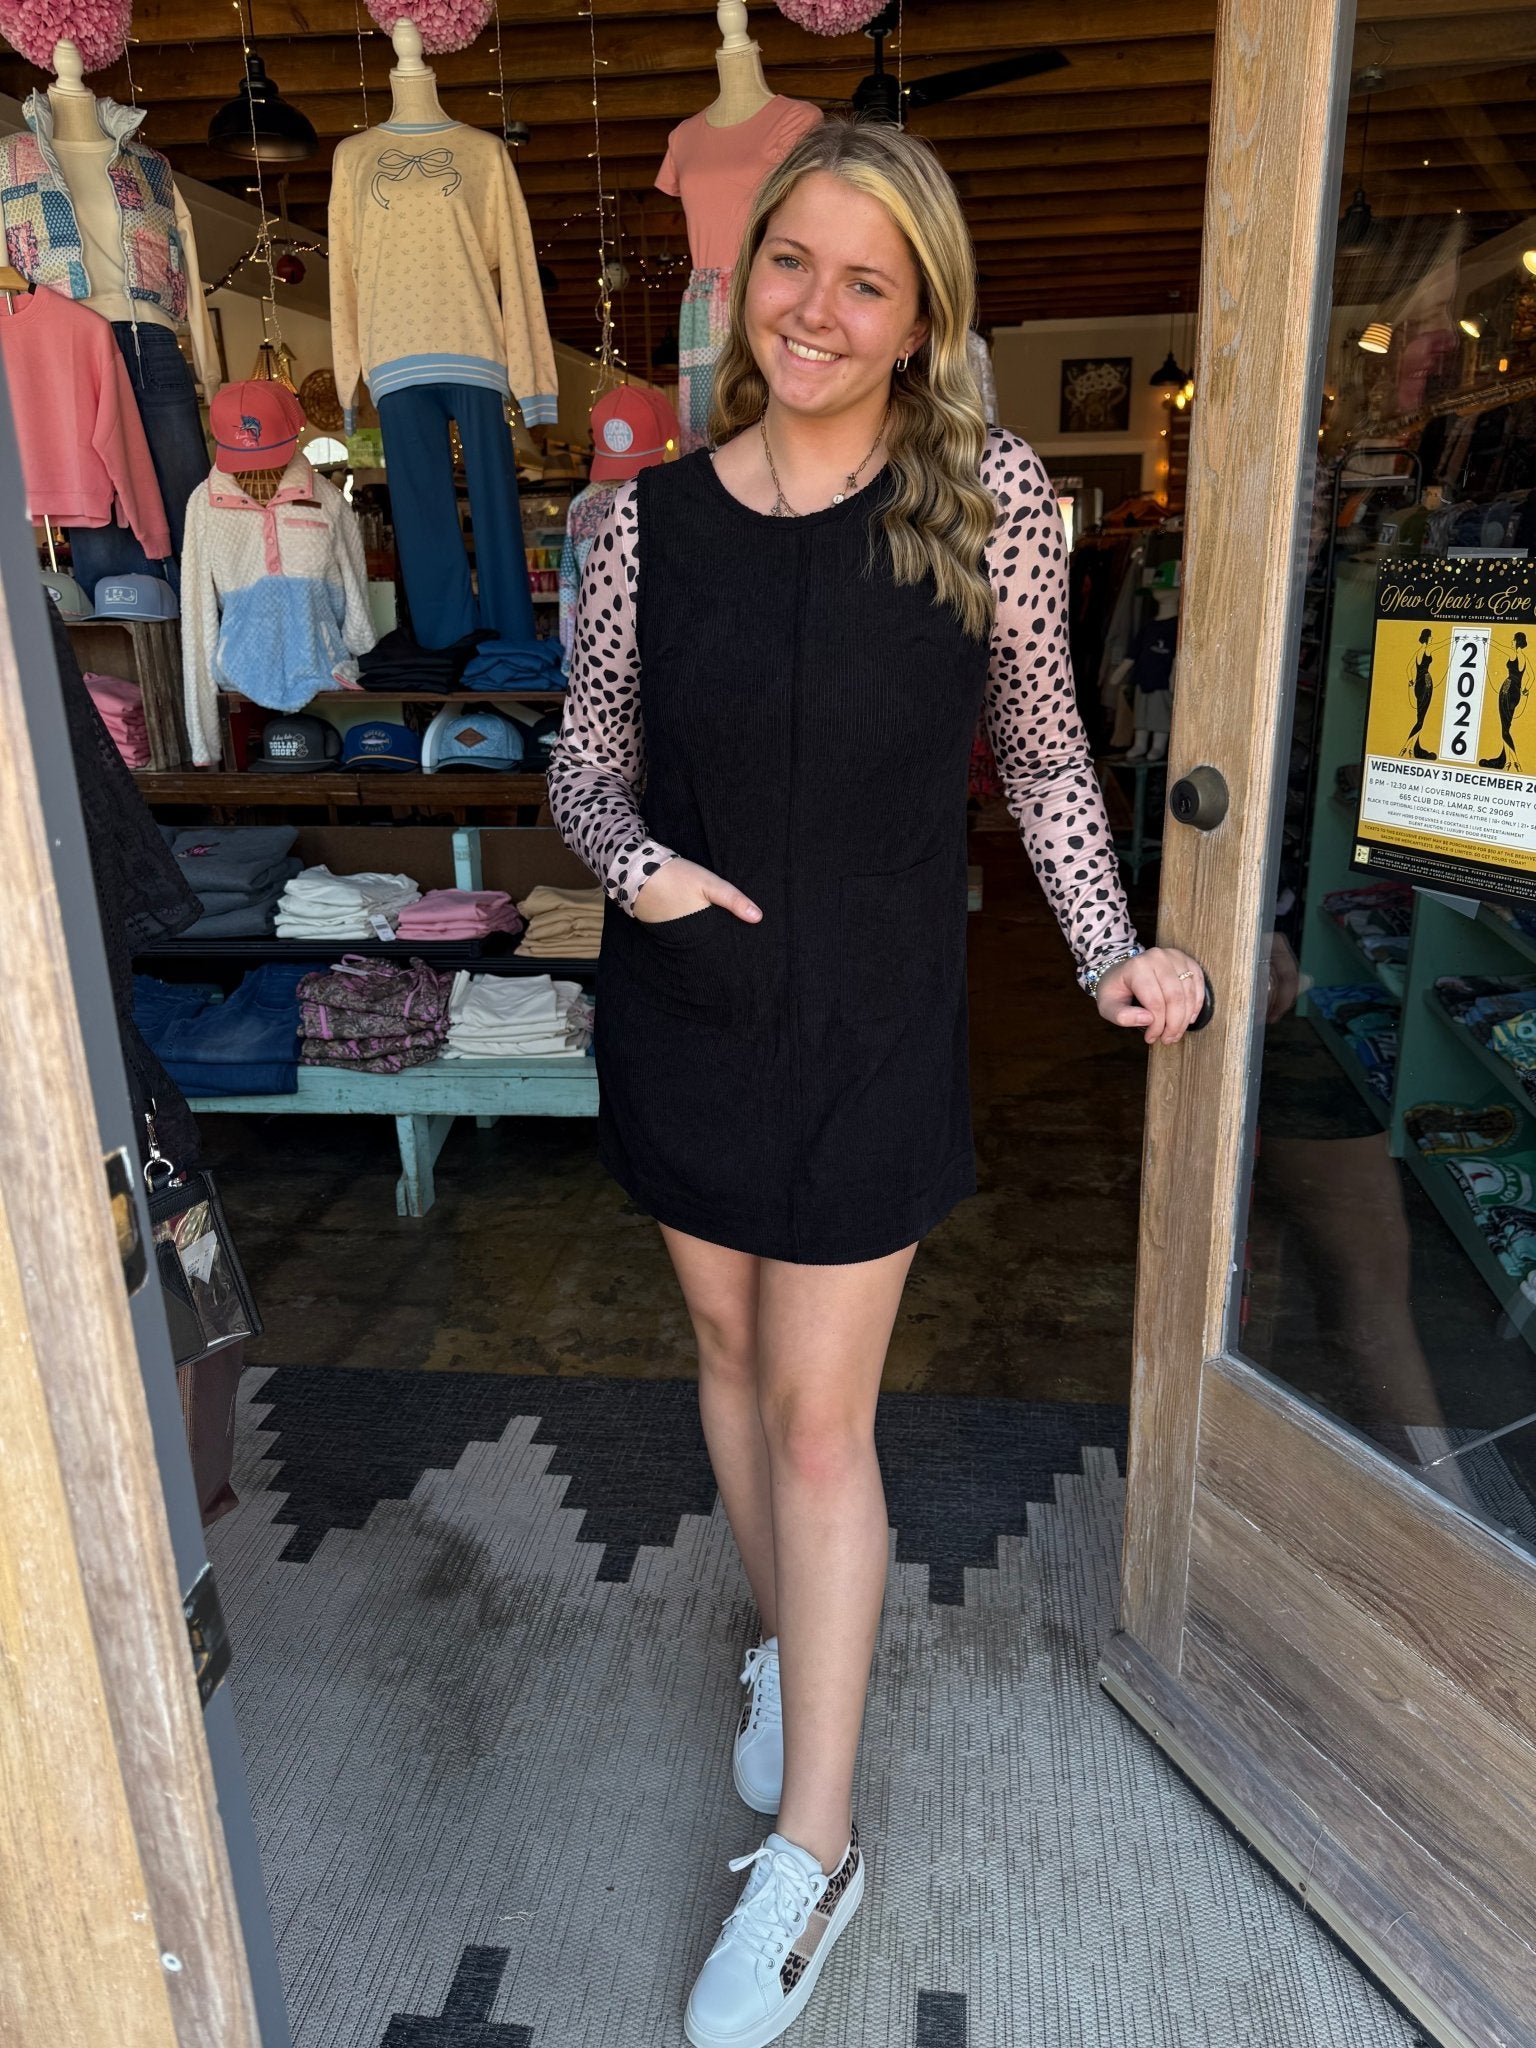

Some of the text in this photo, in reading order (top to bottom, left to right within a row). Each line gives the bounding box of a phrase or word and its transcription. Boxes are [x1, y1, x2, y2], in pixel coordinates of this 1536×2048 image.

[1380, 585, 1532, 615] New Year's Eve
[1451, 642, 1478, 755] 2026
[269, 741, 298, 749] DOLLAR
[1371, 760, 1440, 779] WEDNESDAY
[1441, 770, 1452, 782] 31
[1455, 772, 1523, 792] DECEMBER
[1375, 778, 1385, 786] PM
[1425, 787, 1471, 800] GOVERNORS
[1473, 794, 1490, 803] RUN
[1492, 797, 1532, 809] COUNTRY
[1390, 801, 1413, 809] OPTIONAL
[1417, 806, 1440, 815] COCKTAIL
[1470, 814, 1488, 822] ATTIRE
[1399, 793, 1412, 801] 665
[1413, 796, 1431, 804] CLUB
[1489, 808, 1514, 818] 29069
[1444, 820, 1469, 829] COCKTAILS
[1484, 827, 1525, 838] ENTERTAINMENT
[1480, 832, 1497, 840] PRIZES
[1449, 841, 1476, 850] PURCHASED
